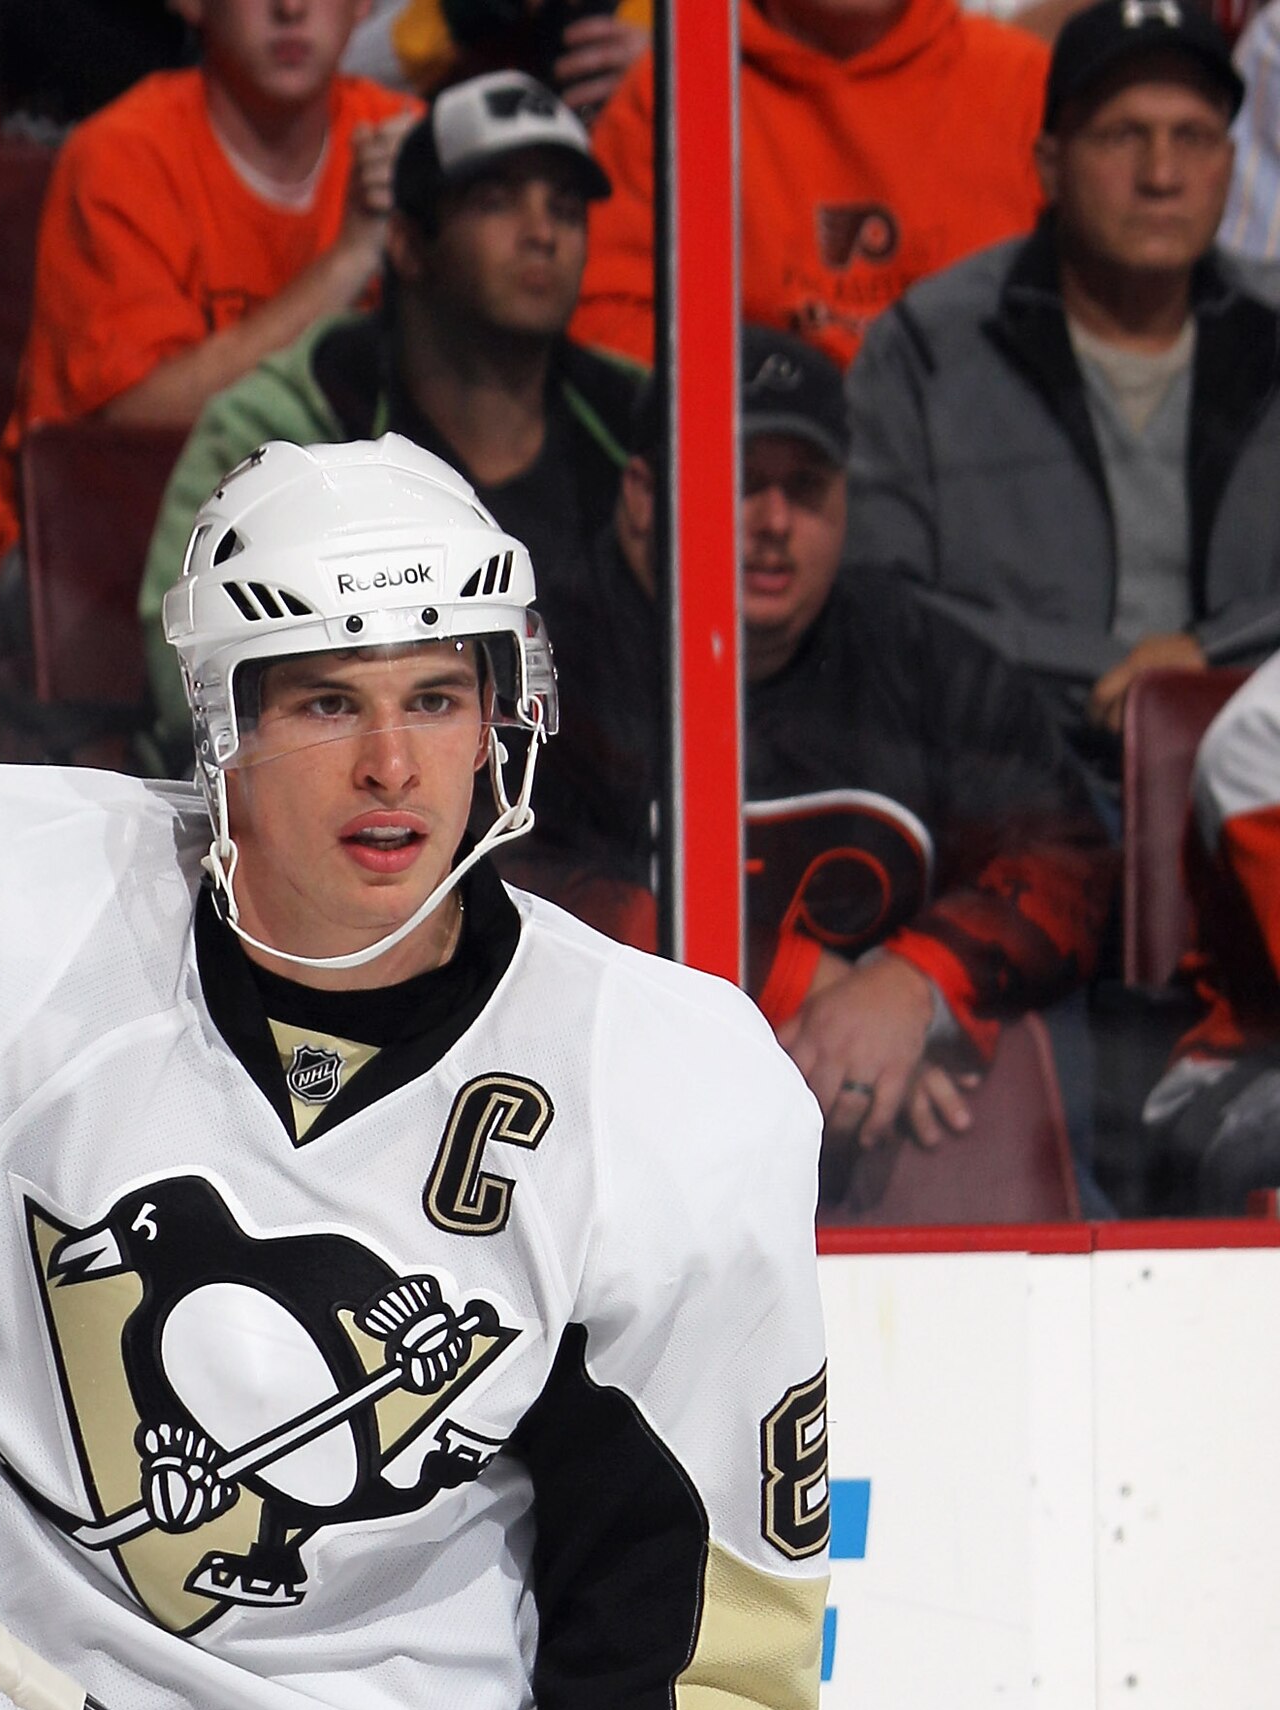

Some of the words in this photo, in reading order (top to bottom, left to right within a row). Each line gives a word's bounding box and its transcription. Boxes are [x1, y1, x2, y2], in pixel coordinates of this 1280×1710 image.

[337, 563, 435, 594] Reebok
[297, 1063, 334, 1090] NHL
[422, 1071, 554, 1236] C
